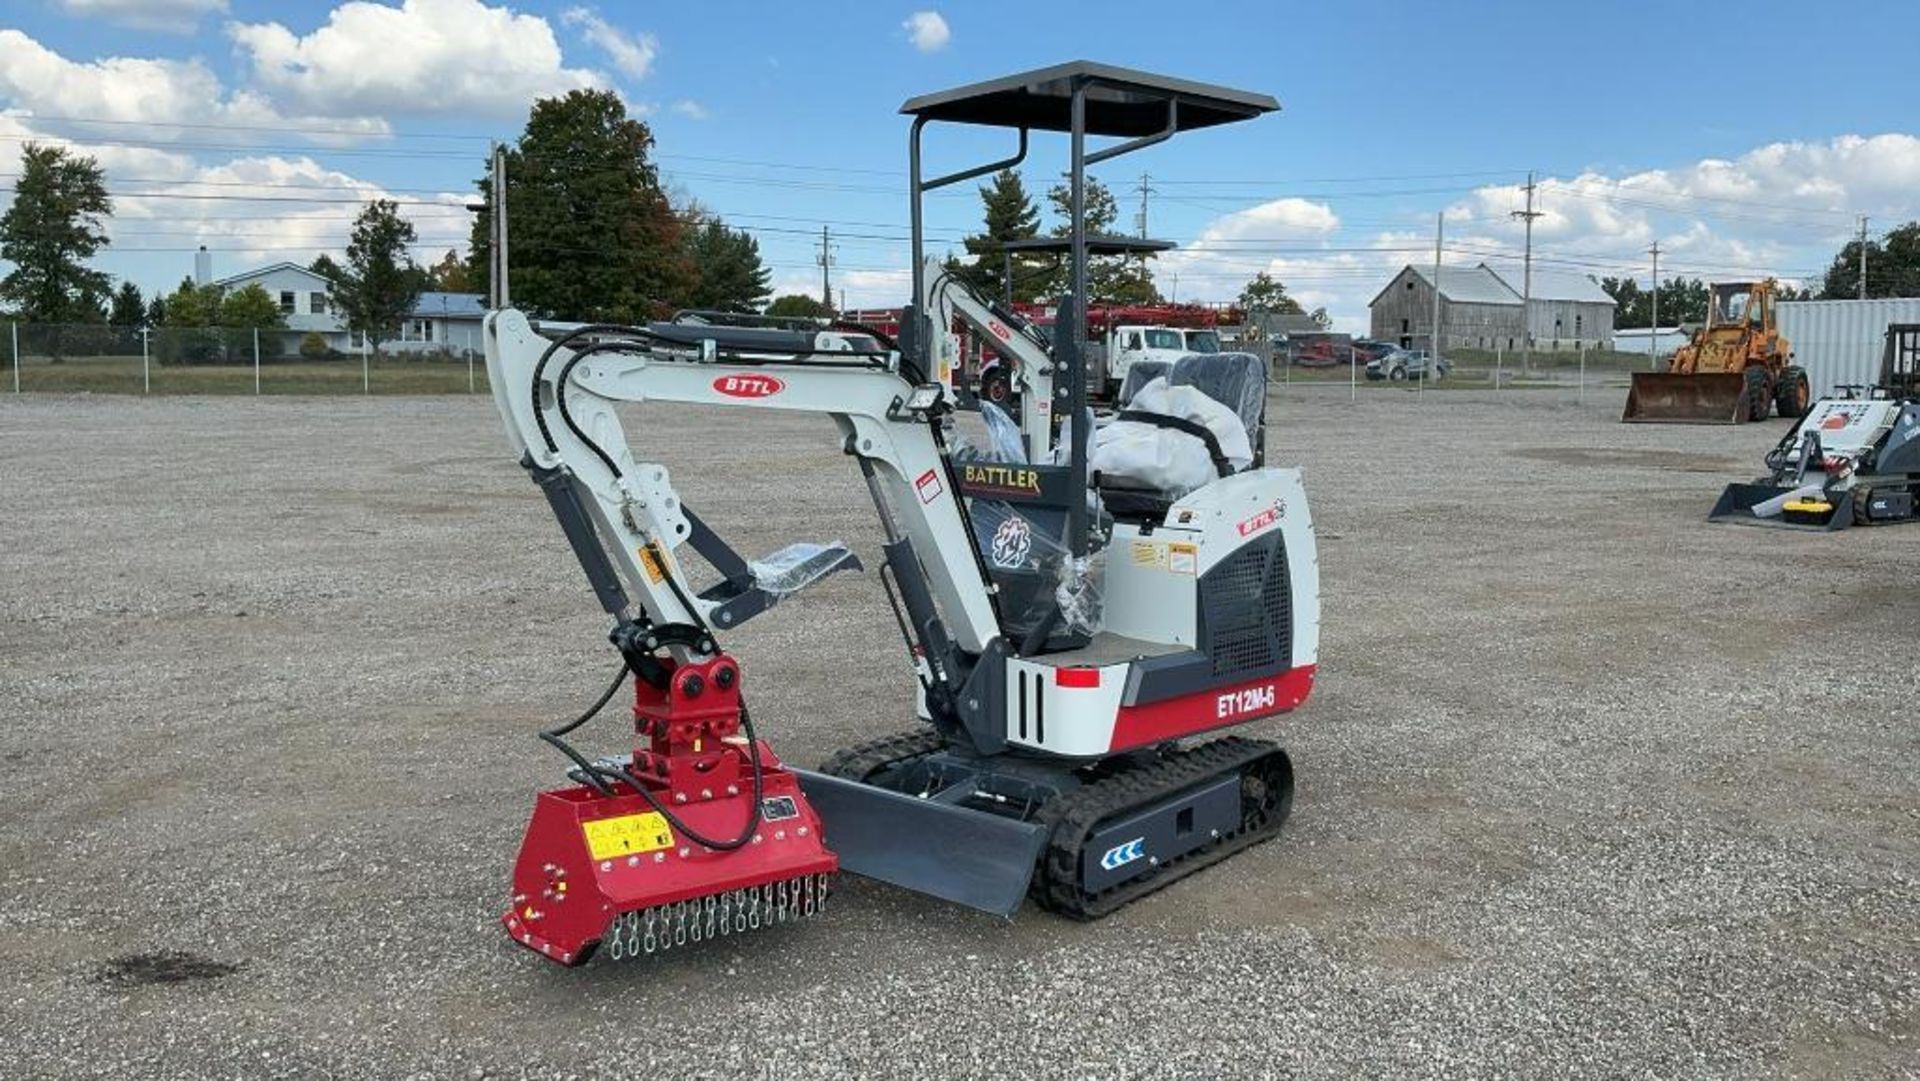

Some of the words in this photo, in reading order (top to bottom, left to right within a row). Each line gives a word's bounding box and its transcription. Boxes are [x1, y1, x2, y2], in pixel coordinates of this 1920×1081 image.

[726, 377, 770, 394] BTTL
[965, 465, 1041, 493] BATTLER
[1218, 685, 1275, 718] ET12M-6
